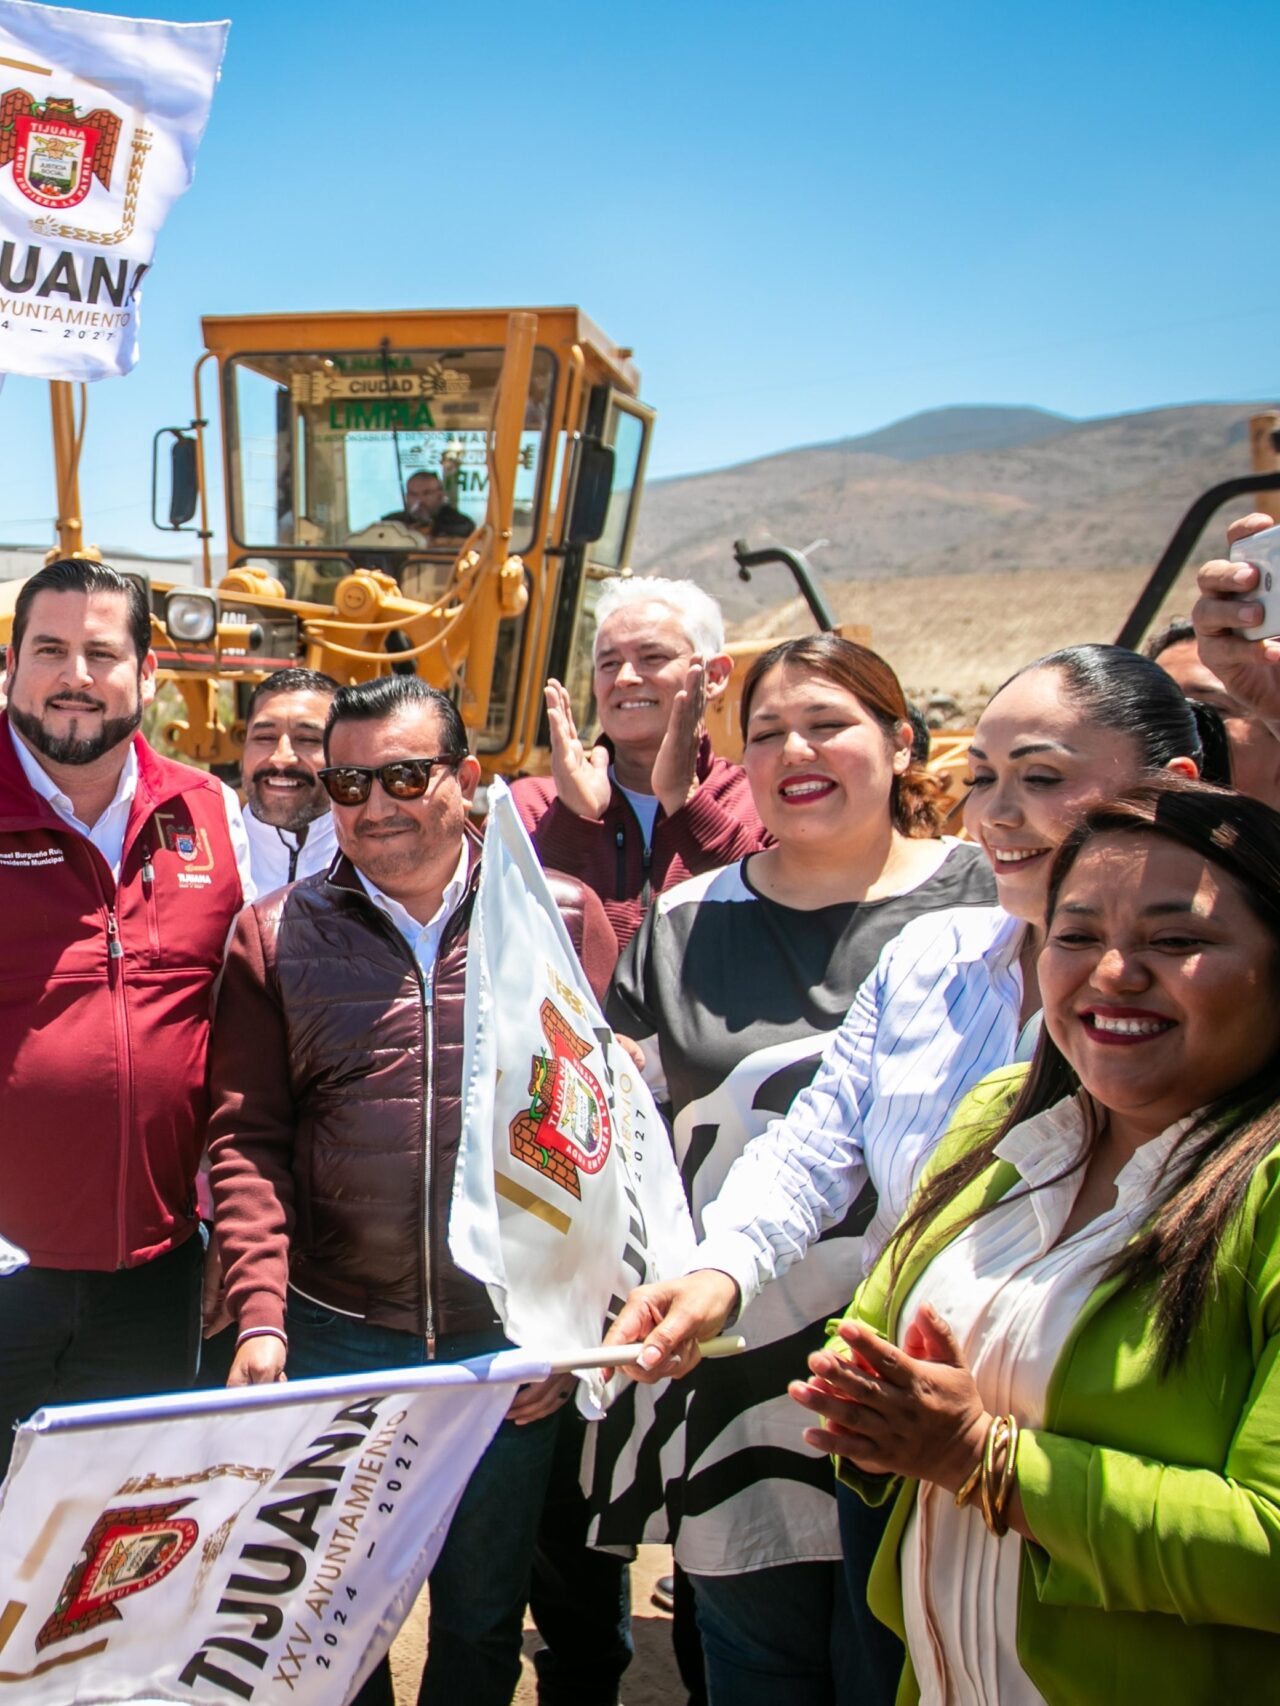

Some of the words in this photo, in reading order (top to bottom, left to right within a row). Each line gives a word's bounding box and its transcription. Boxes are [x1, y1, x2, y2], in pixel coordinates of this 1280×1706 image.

[30, 122, 86, 139] TIJUANA
[63, 329, 116, 341] 2027
[349, 379, 413, 394] CIUDAD
[329, 403, 435, 430] LIMPIA
[31, 856, 65, 866] Municipal
[548, 1055, 567, 1126] TIJUANA
[178, 1397, 385, 1701] TIJUANA
[273, 1621, 312, 1690] XXV
[305, 1410, 407, 1619] AYUNTAMIENTO
